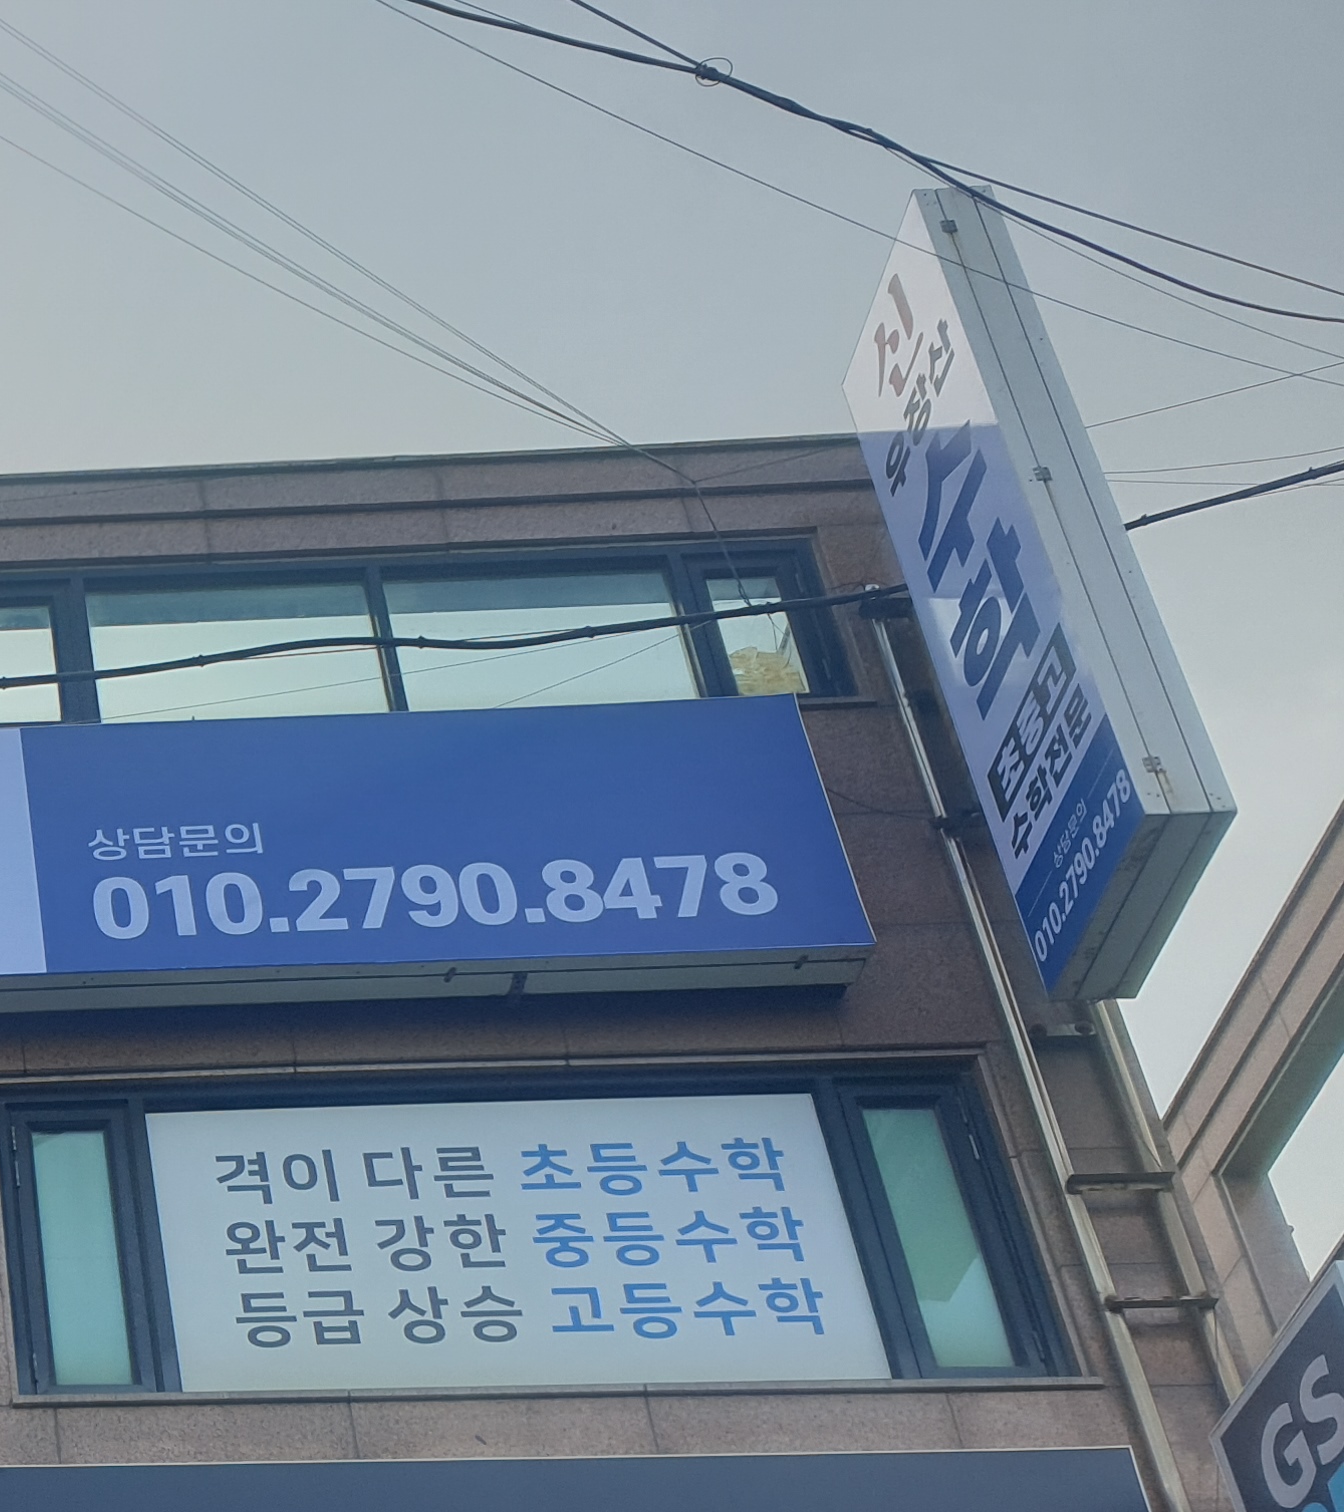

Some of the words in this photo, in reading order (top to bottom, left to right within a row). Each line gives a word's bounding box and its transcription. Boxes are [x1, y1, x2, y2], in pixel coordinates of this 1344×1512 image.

[874, 273, 924, 398] 신
[885, 318, 955, 497] 우장산
[918, 420, 1041, 721] 수학
[997, 646, 1067, 802] 초중고
[1012, 683, 1092, 859] 수학전문
[86, 822, 266, 862] 상담문의
[1034, 769, 1131, 962] 010.2790.8478
[1053, 798, 1087, 869] 상담문의
[92, 851, 780, 942] 010.2790.8478
[214, 1149, 340, 1205] 격이
[362, 1146, 496, 1200] 다른
[519, 1137, 786, 1197] 초등수학
[224, 1216, 350, 1275] 완전
[374, 1213, 507, 1272] 강한
[532, 1206, 806, 1268] 중등수학
[234, 1289, 365, 1348] 등급
[387, 1285, 523, 1344] 상승
[551, 1277, 826, 1341] 고등수학
[1261, 1354, 1344, 1508] GS
